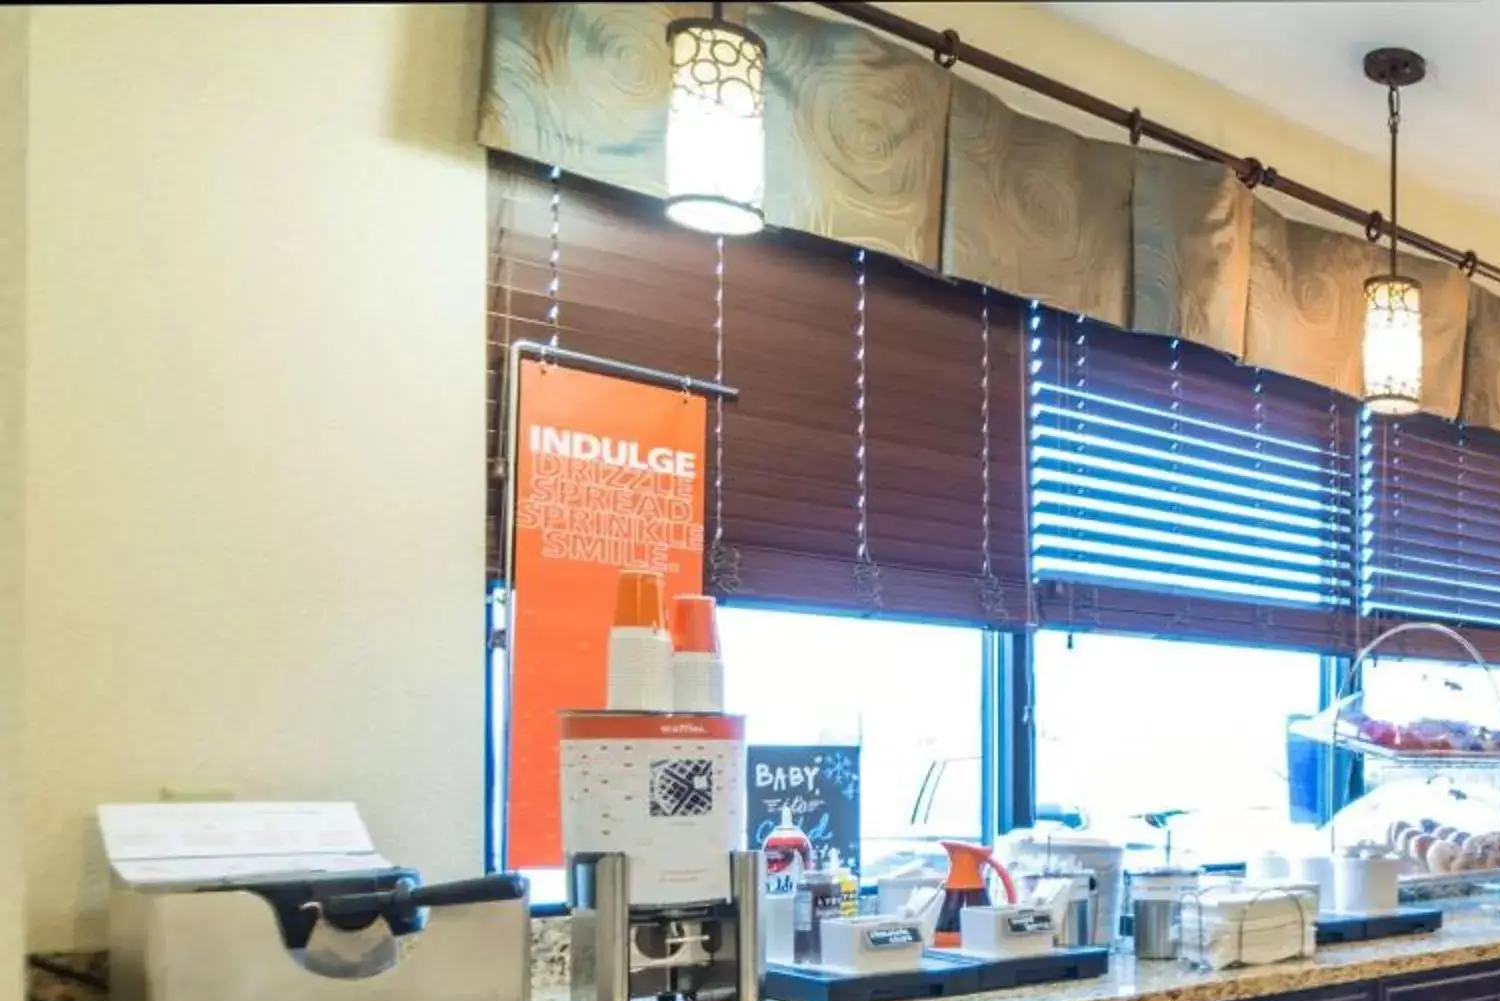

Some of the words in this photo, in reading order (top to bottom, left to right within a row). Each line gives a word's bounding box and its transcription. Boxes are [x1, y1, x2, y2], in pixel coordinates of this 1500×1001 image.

[529, 425, 696, 479] INDULGE
[529, 475, 694, 524] SPREAD
[533, 453, 694, 504] DRIZZLE
[516, 501, 705, 553] SPRINKLE
[541, 530, 681, 573] SMILE.
